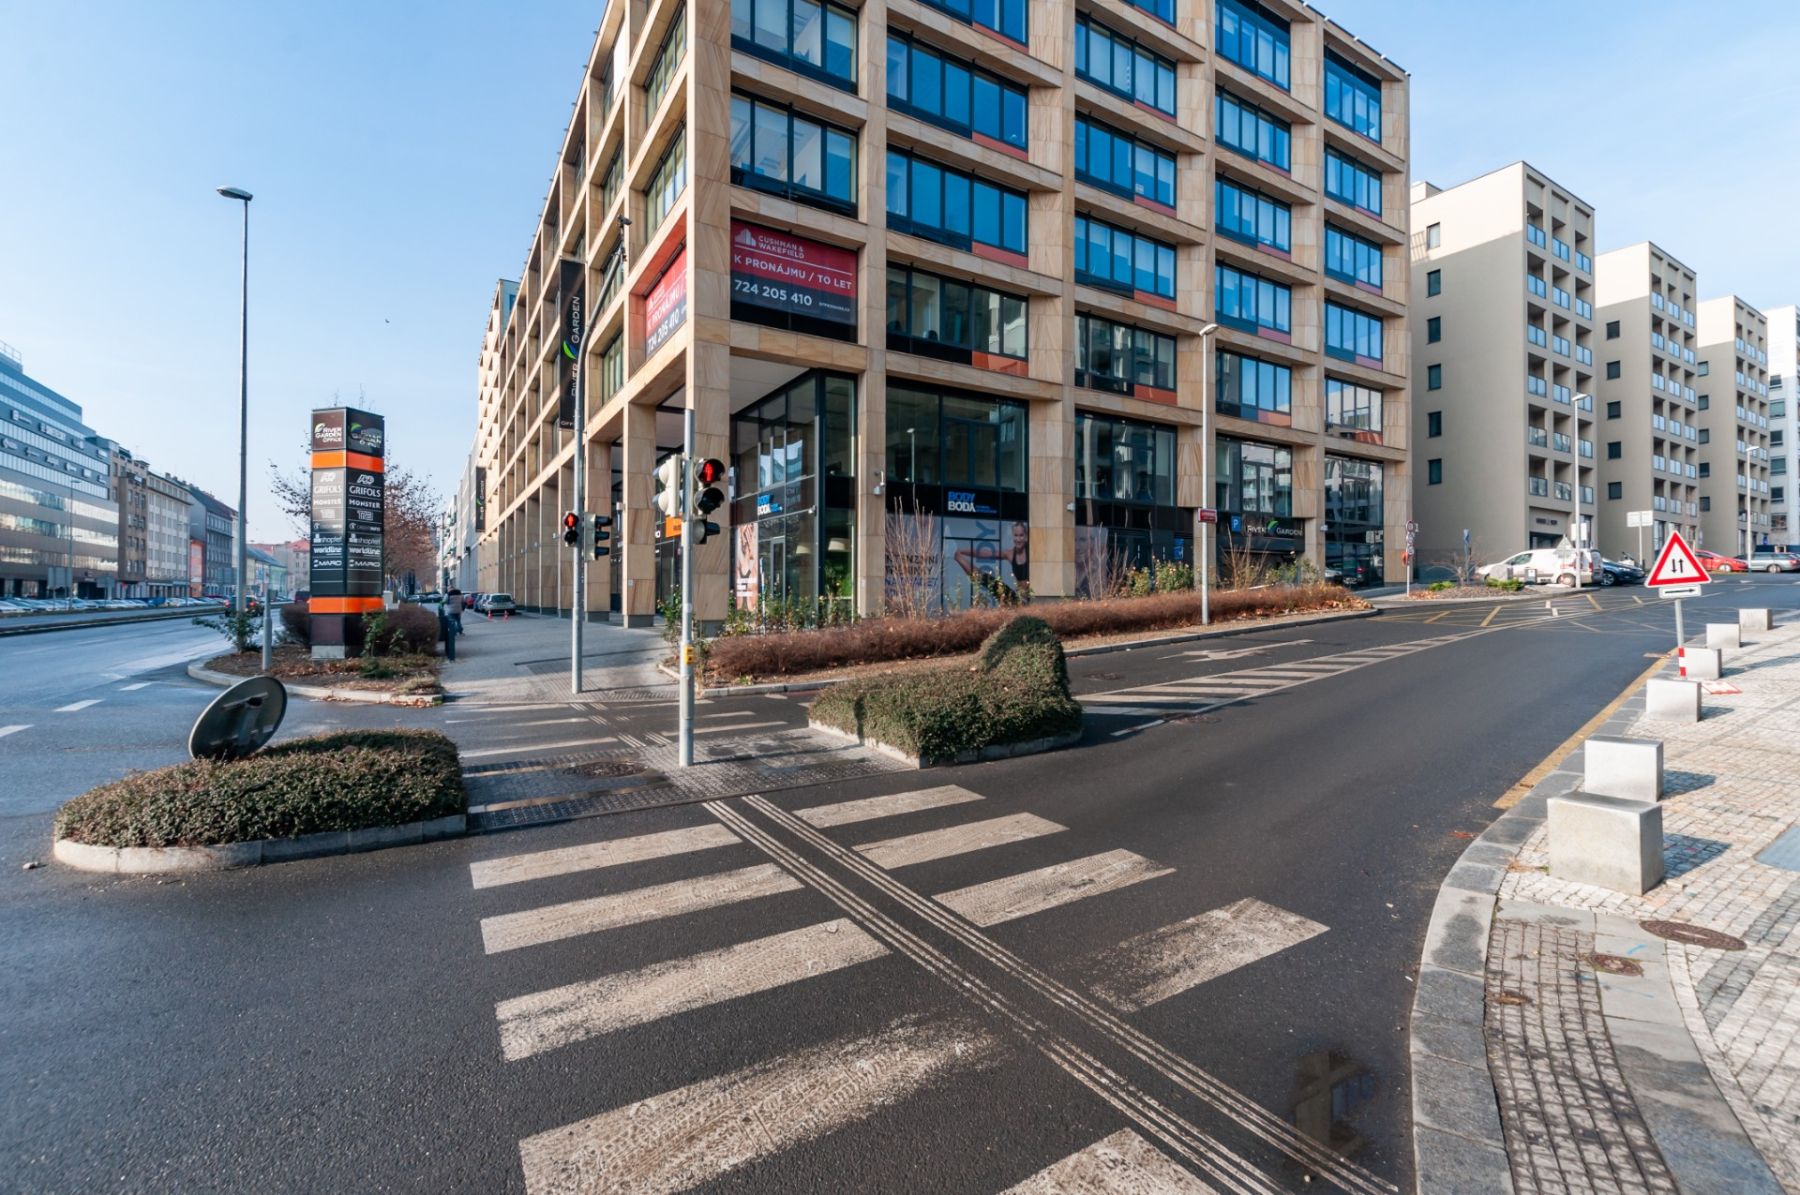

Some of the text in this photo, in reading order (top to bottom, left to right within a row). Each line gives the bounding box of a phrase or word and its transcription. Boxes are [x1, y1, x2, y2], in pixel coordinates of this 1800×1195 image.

[758, 235, 798, 250] CUSHMAN
[758, 242, 805, 259] WAKEFIELD
[734, 254, 852, 290] K PRONÁJMU / TO LET
[734, 279, 813, 306] 724 205 410
[571, 295, 581, 344] GARDEN
[314, 485, 342, 494] GRIFOLS
[349, 486, 381, 498] GRIFOLS
[313, 498, 342, 506] MONSTER
[349, 499, 381, 509] MONSTER
[948, 501, 976, 513] BODA
